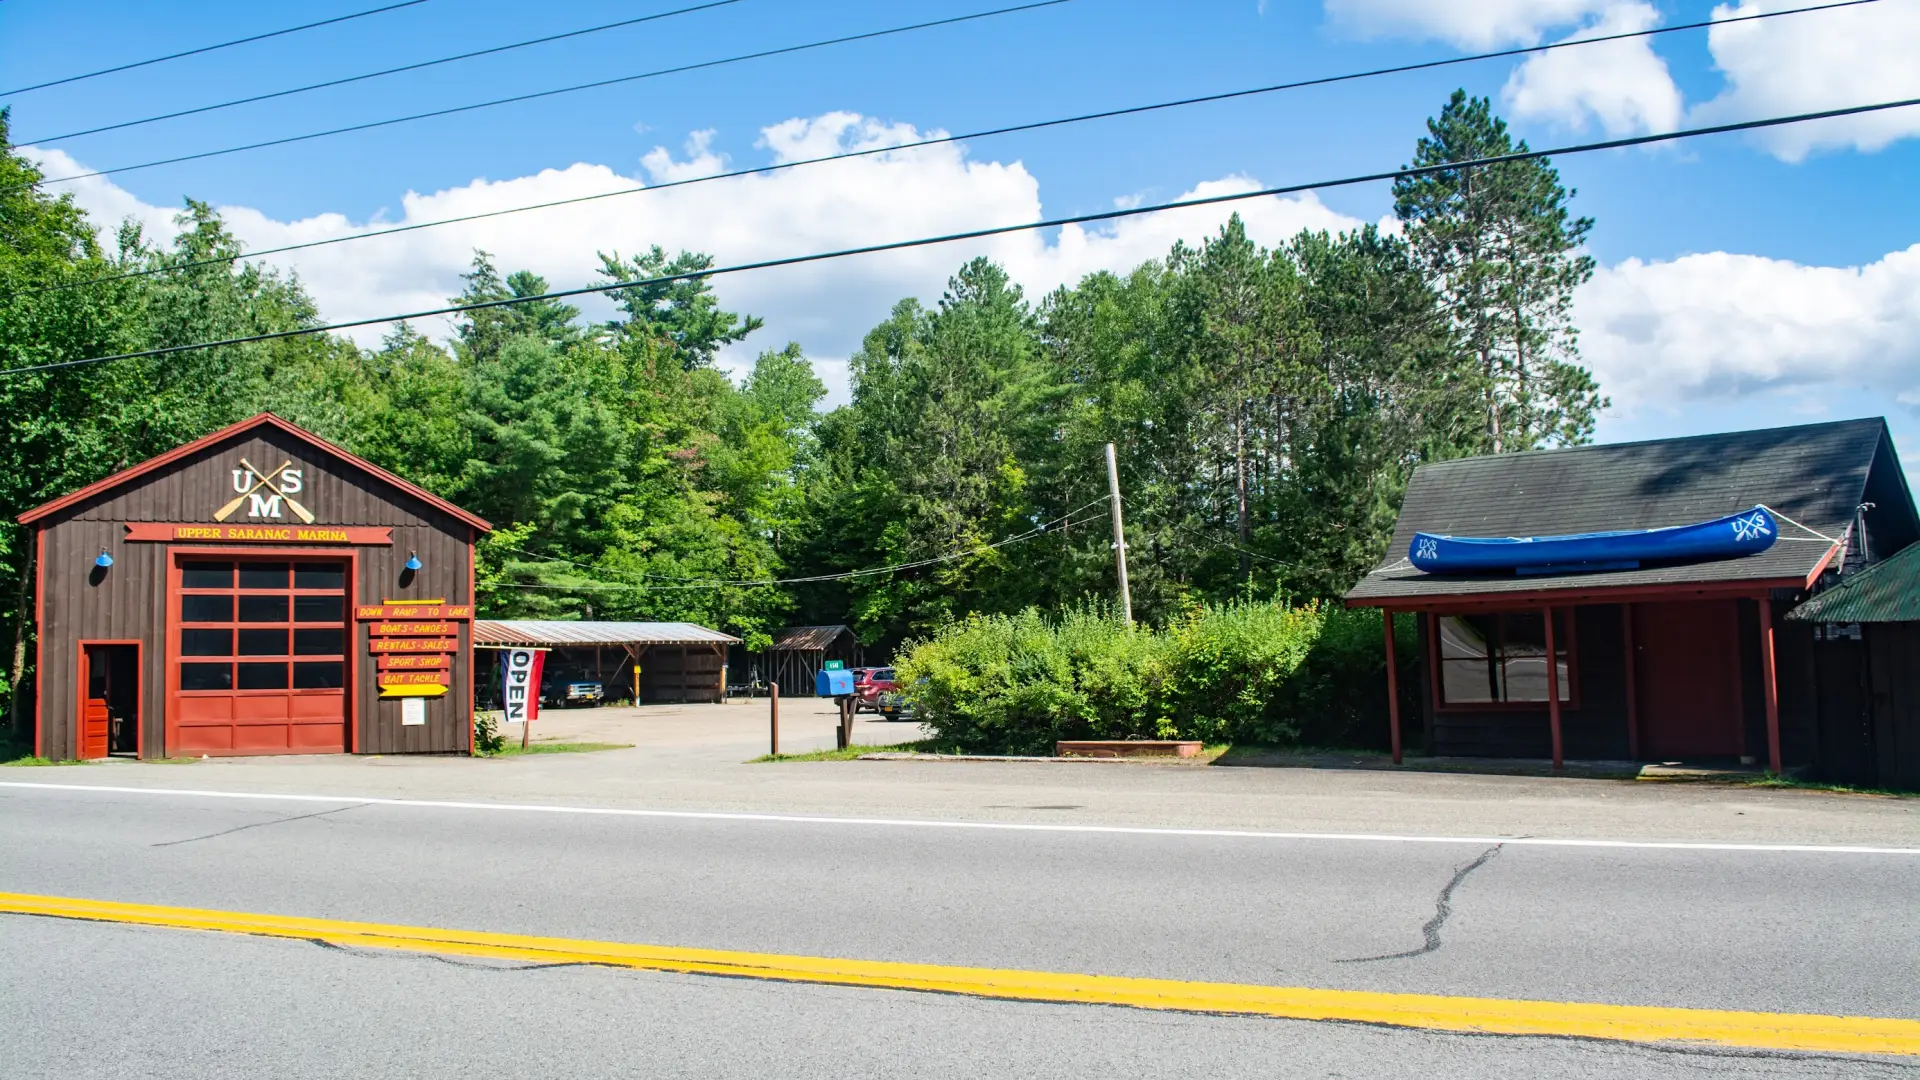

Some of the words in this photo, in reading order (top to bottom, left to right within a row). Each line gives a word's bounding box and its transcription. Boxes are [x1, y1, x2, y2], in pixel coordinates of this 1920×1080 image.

[178, 527, 221, 538] UPPER
[228, 528, 291, 540] SARANAC
[297, 529, 348, 541] MARINA
[360, 608, 383, 616] DOWN
[392, 608, 418, 616] RAMP
[428, 608, 440, 616] TO
[448, 608, 470, 616] LAKE
[387, 658, 416, 667] SPORT
[419, 657, 442, 666] SHOP
[384, 674, 404, 684] BAIT
[409, 674, 441, 683] TACKLE
[509, 651, 530, 719] OPEN
